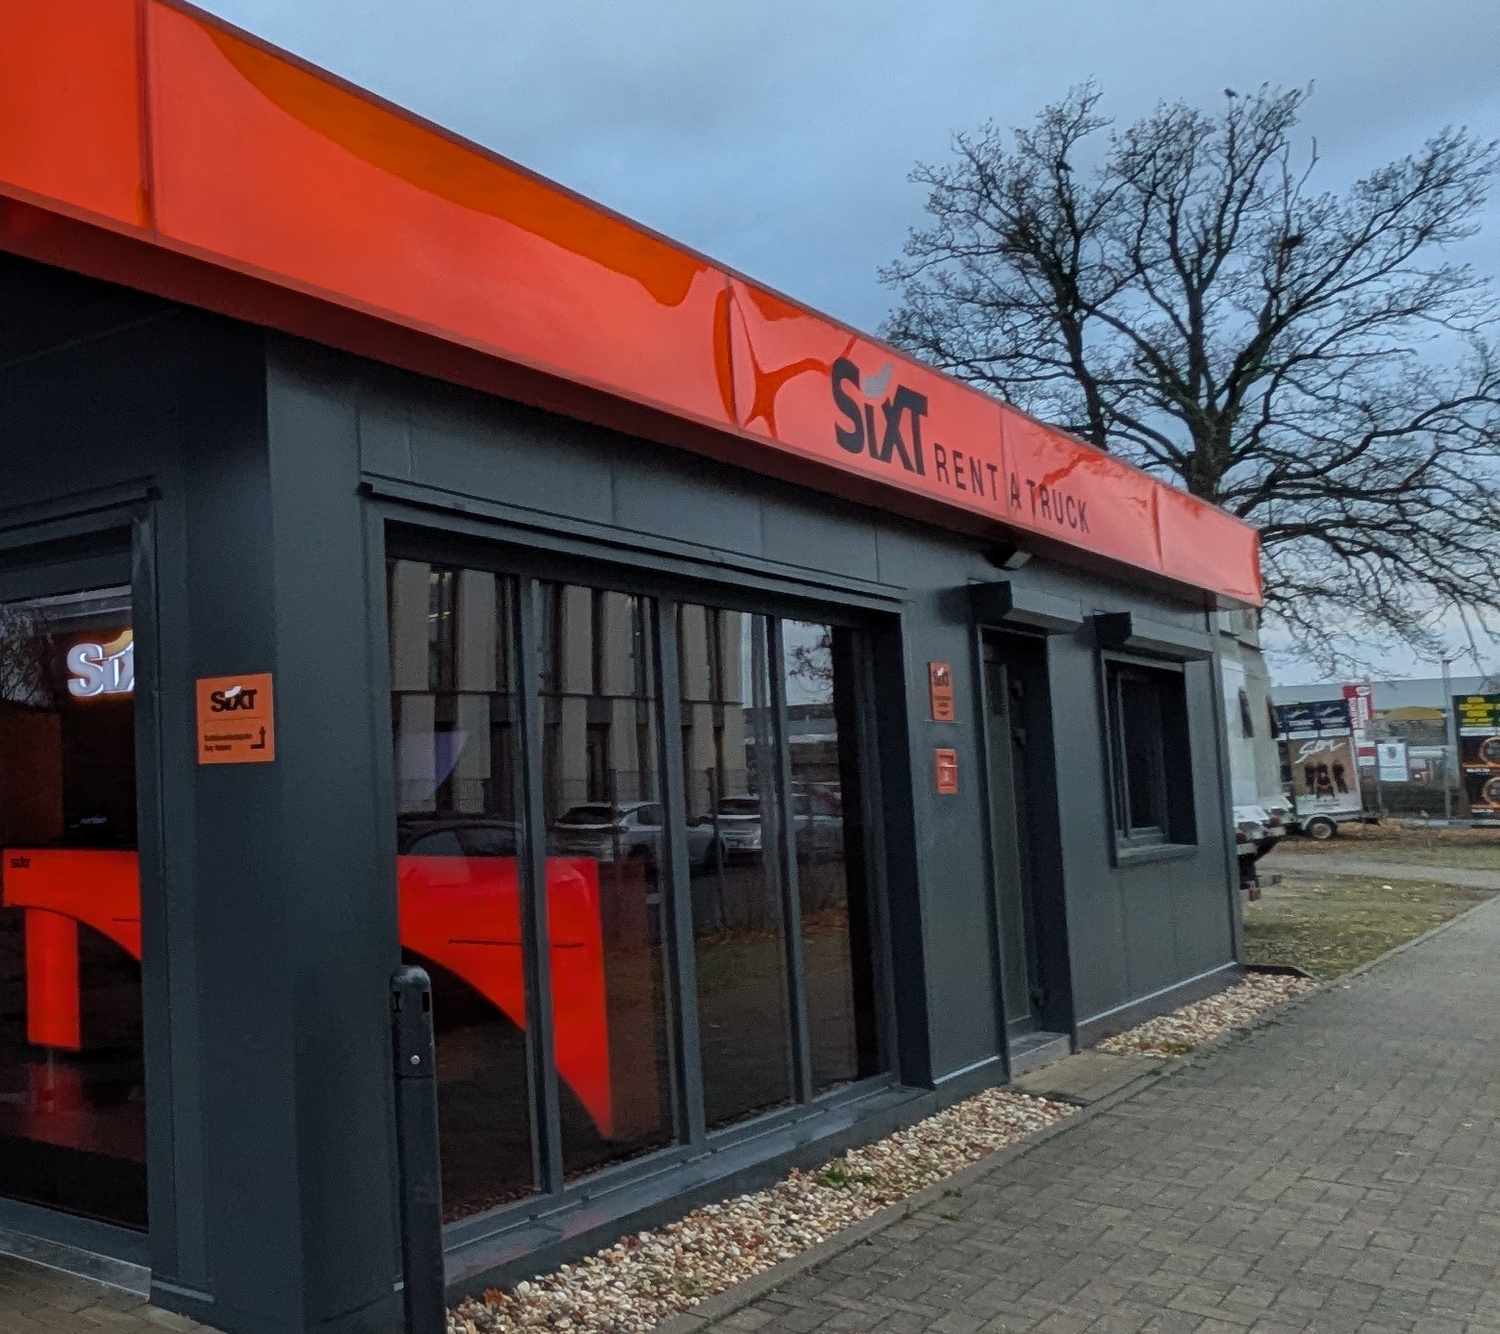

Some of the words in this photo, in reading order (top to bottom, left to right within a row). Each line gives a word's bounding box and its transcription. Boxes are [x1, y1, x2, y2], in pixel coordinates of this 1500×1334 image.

[934, 442, 997, 501] RENT
[1010, 472, 1021, 511] A
[1026, 478, 1091, 534] TRUCK
